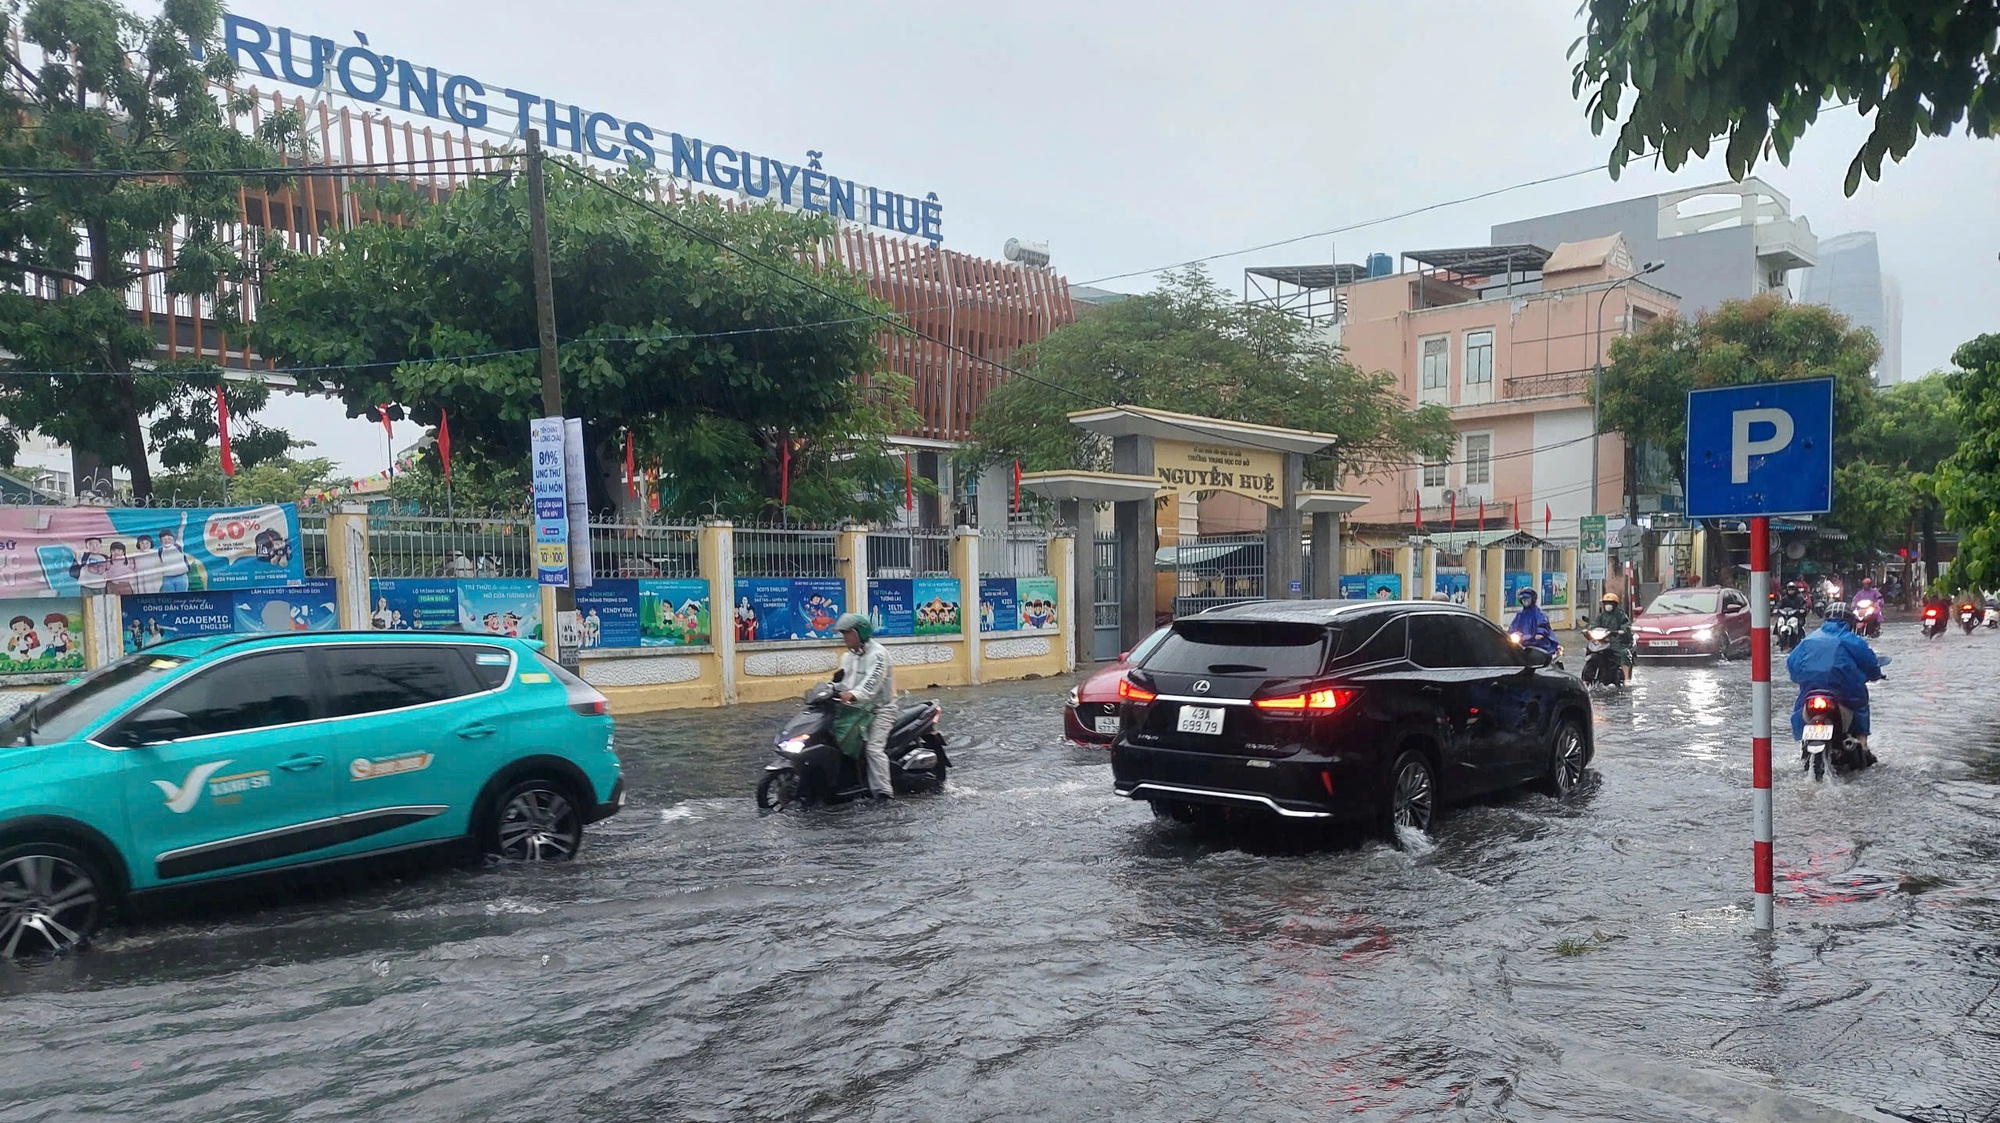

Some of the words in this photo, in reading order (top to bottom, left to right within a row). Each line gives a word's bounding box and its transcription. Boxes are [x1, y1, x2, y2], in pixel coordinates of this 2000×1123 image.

[188, 12, 487, 128] RƯỜNG
[505, 89, 655, 169] THCS
[672, 133, 855, 221] NGUYỄN
[870, 186, 944, 249] HUỆ
[1731, 407, 1794, 484] P
[539, 450, 558, 465] 80%
[536, 470, 548, 478] UNG
[549, 467, 561, 478] THƯ
[1158, 466, 1234, 487] NGUYỄN
[1239, 473, 1274, 493] HUỆ
[535, 482, 548, 496] HẬU
[549, 481, 563, 492] MÔN
[209, 520, 260, 540] 40%
[180, 603, 198, 611] TOÀN
[175, 615, 229, 625] ACADEMIC
[1192, 709, 1210, 720] 43A
[1182, 720, 1217, 732] 699.79
